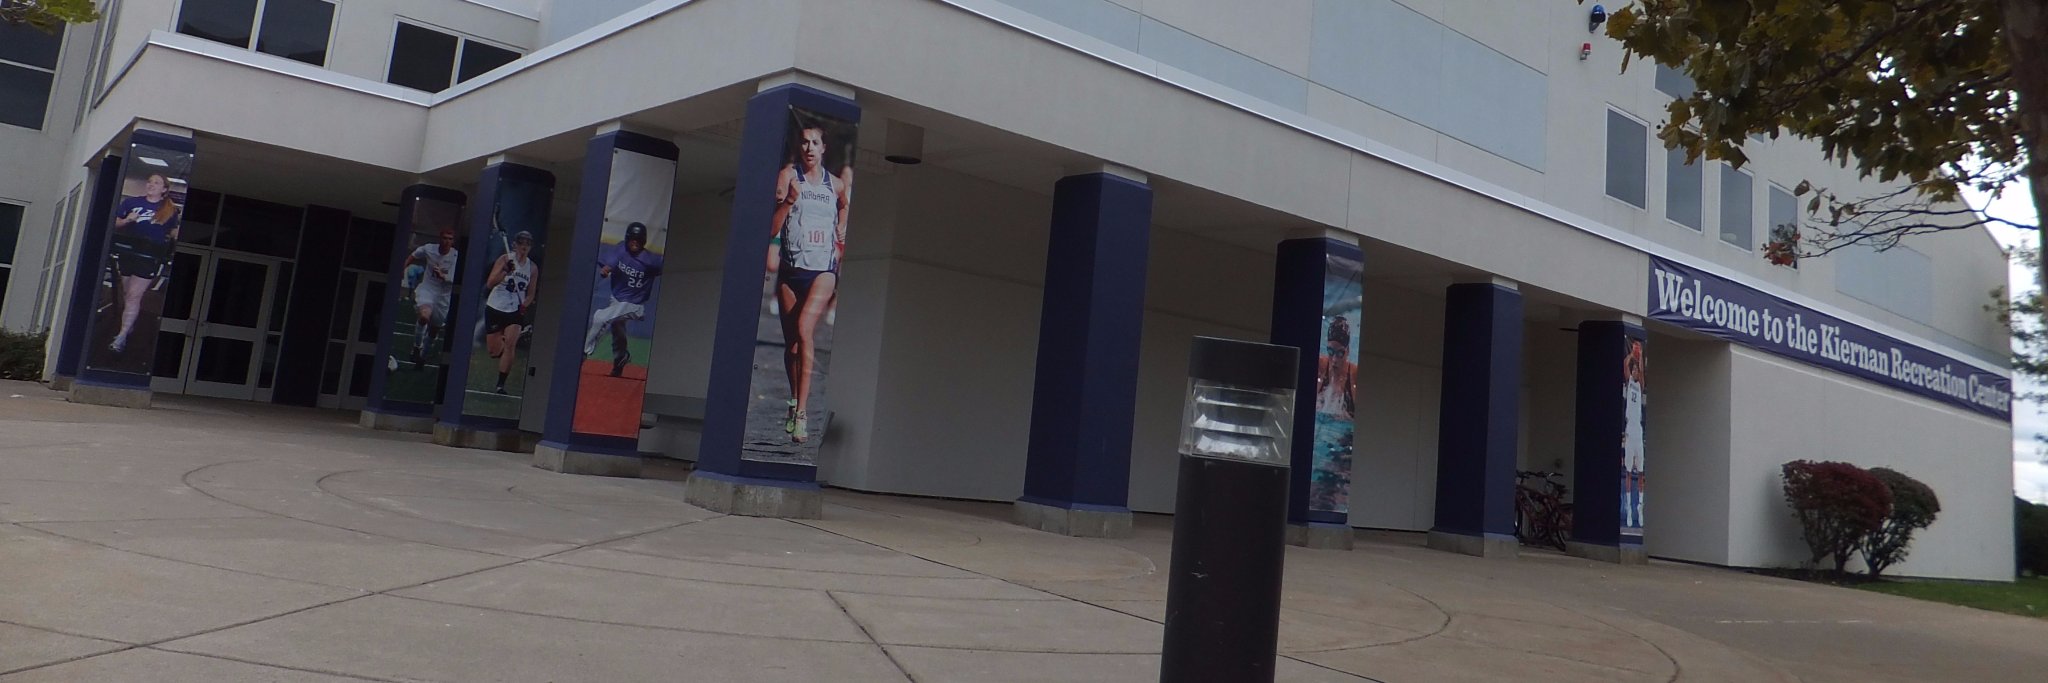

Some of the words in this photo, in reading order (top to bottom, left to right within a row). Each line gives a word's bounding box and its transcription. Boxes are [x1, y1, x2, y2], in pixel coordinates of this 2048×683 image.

[808, 230, 825, 243] 101
[628, 277, 644, 288] 26
[1655, 268, 1759, 336] Welcome
[1762, 308, 1783, 344] to
[1786, 314, 1818, 354] the
[1820, 323, 1889, 376] Kiernan
[1890, 348, 1967, 399] Recreation
[1969, 374, 2010, 412] Center
